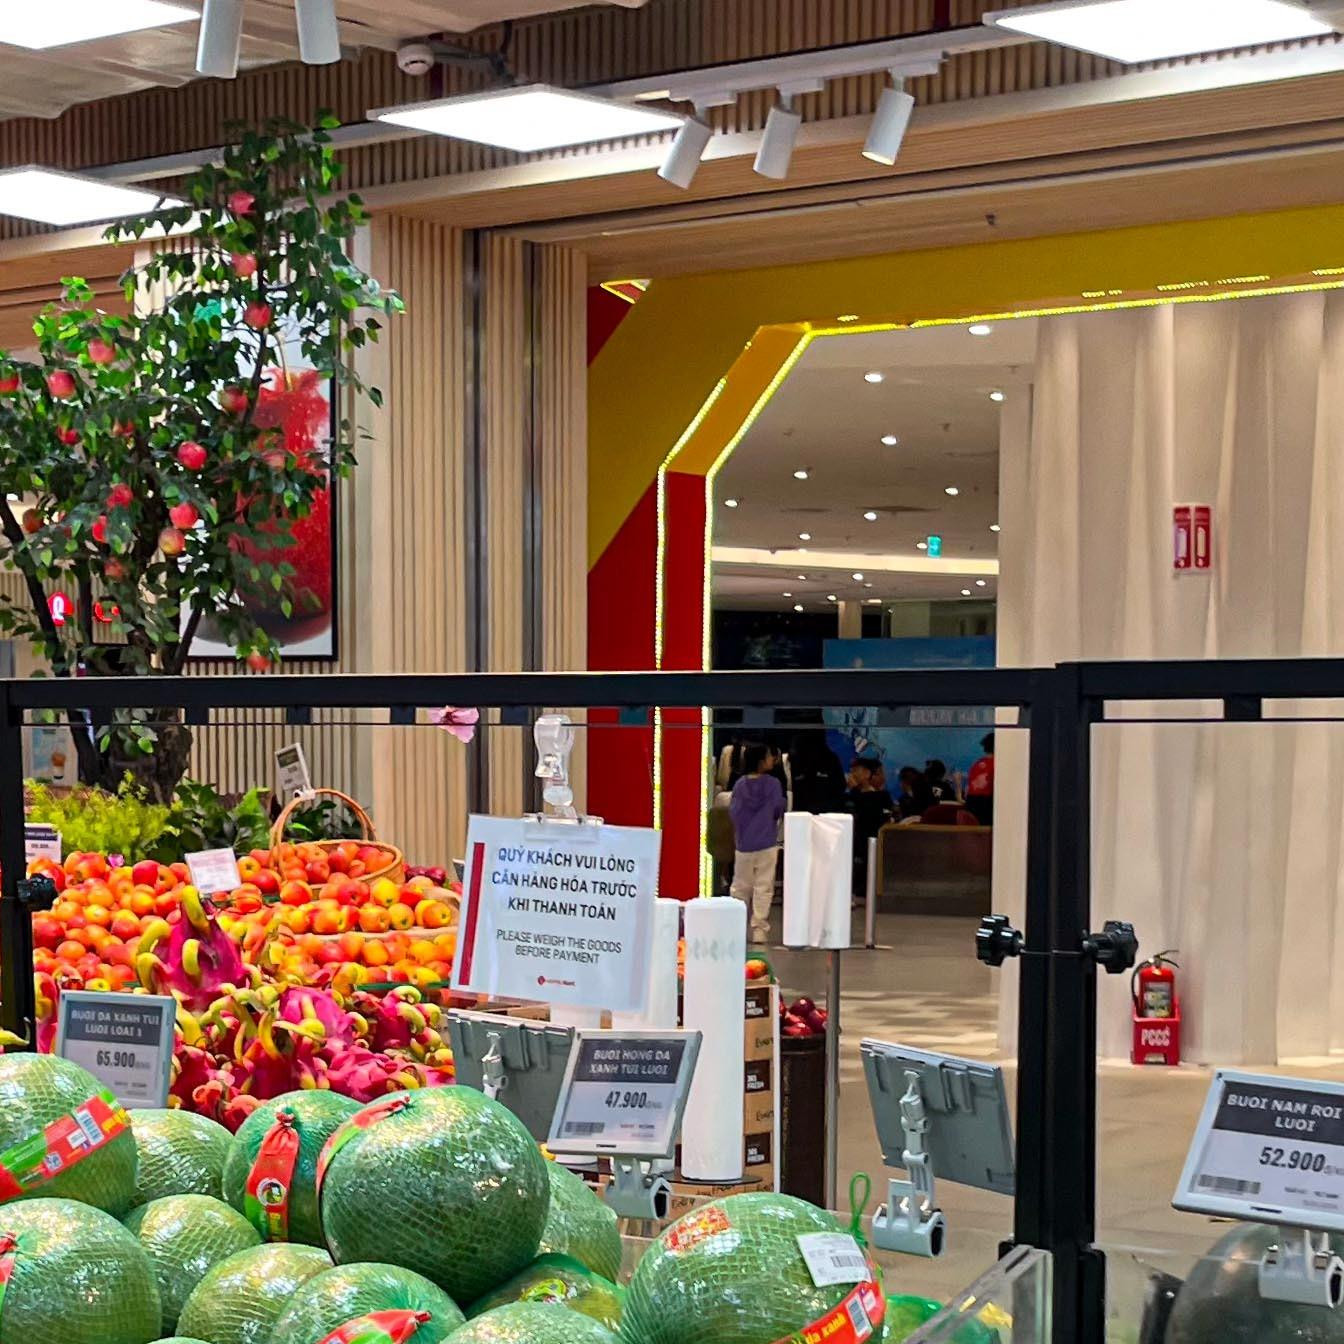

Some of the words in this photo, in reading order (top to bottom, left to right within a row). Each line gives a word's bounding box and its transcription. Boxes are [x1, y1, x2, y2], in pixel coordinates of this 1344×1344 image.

[526, 848, 572, 869] KHÁCH
[575, 853, 597, 869] VUI
[599, 851, 635, 873] LÒNG
[521, 869, 557, 891] HÀNG
[560, 873, 588, 893] HÓA
[591, 877, 638, 899] TRƯỚC
[508, 896, 530, 912] KHI
[532, 898, 577, 917] THANH
[580, 901, 617, 921] TOÁN
[496, 928, 532, 945] PLEASE
[533, 932, 565, 948] WEIGH
[567, 936, 587, 950] THE
[587, 938, 622, 954] GOODS
[515, 944, 551, 960] BEFORE
[553, 948, 600, 965] PAYMENT
[96, 1050, 136, 1069] 65.900
[605, 1090, 647, 1109] 47.900
[1226, 1093, 1268, 1110] BUOI
[1271, 1098, 1307, 1115] NAM
[1310, 1103, 1341, 1120] ROI
[1274, 1116, 1316, 1133] LUOI
[1258, 1146, 1326, 1173] 52.900
